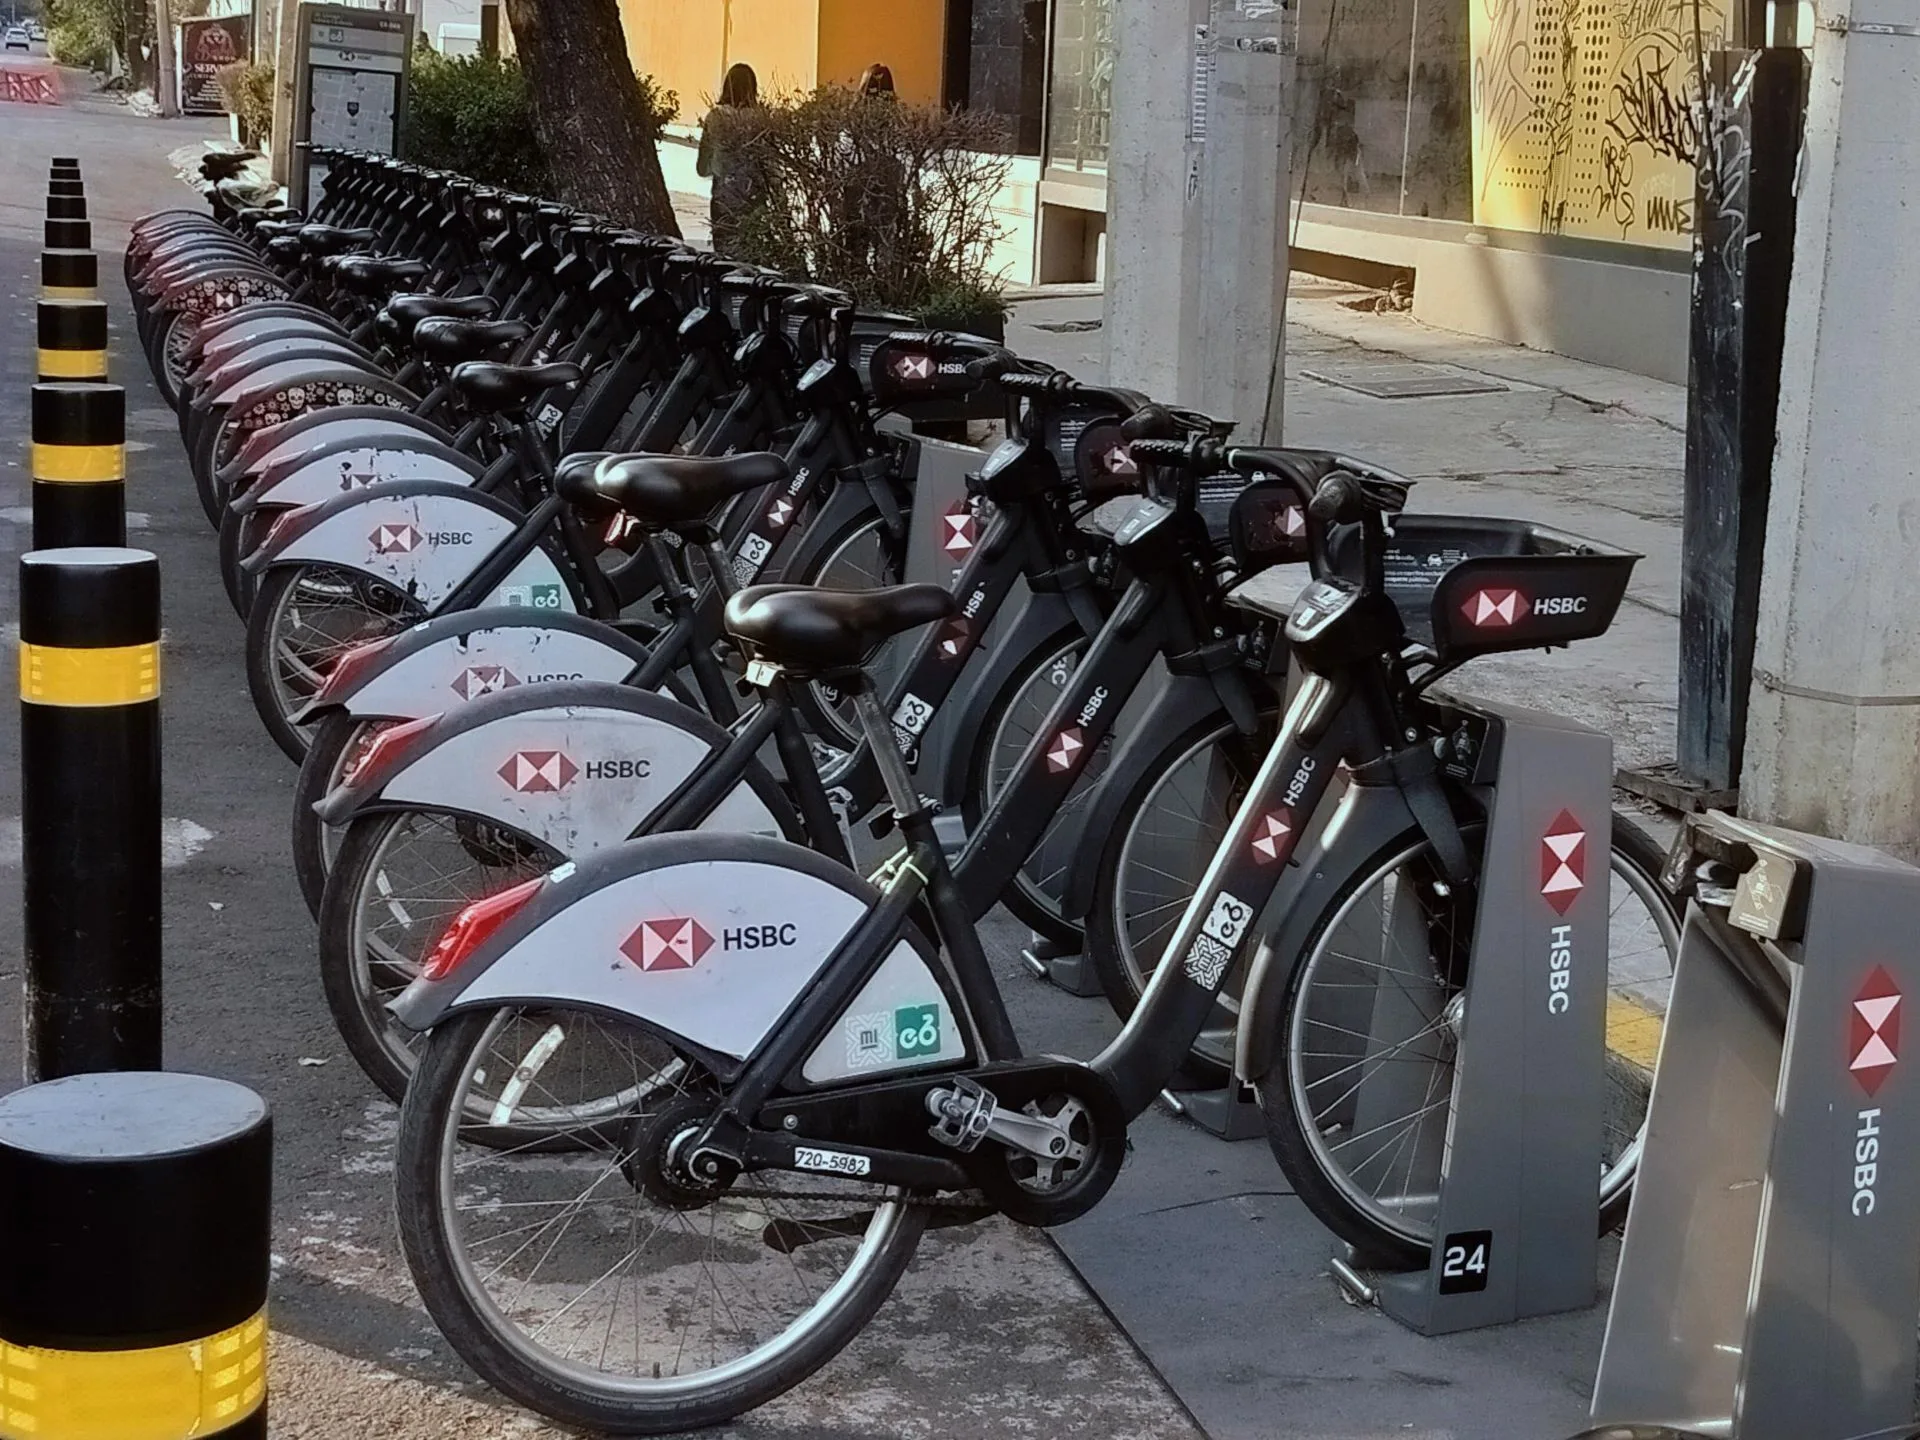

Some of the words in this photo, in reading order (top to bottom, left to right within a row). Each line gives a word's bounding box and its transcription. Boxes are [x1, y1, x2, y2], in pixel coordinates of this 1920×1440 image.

[787, 467, 811, 497] HSBC
[428, 532, 473, 546] HSBC
[962, 582, 986, 619] HSB
[1533, 597, 1588, 616] HSBC
[1076, 685, 1109, 727] HSBC
[586, 759, 651, 780] HSBC
[1282, 756, 1316, 808] HSBC
[723, 923, 797, 951] HSBC
[1548, 924, 1572, 1015] HSBC
[795, 1150, 866, 1173] 720-5982
[1851, 1107, 1881, 1217] HSBC
[1443, 1243, 1486, 1277] 24
